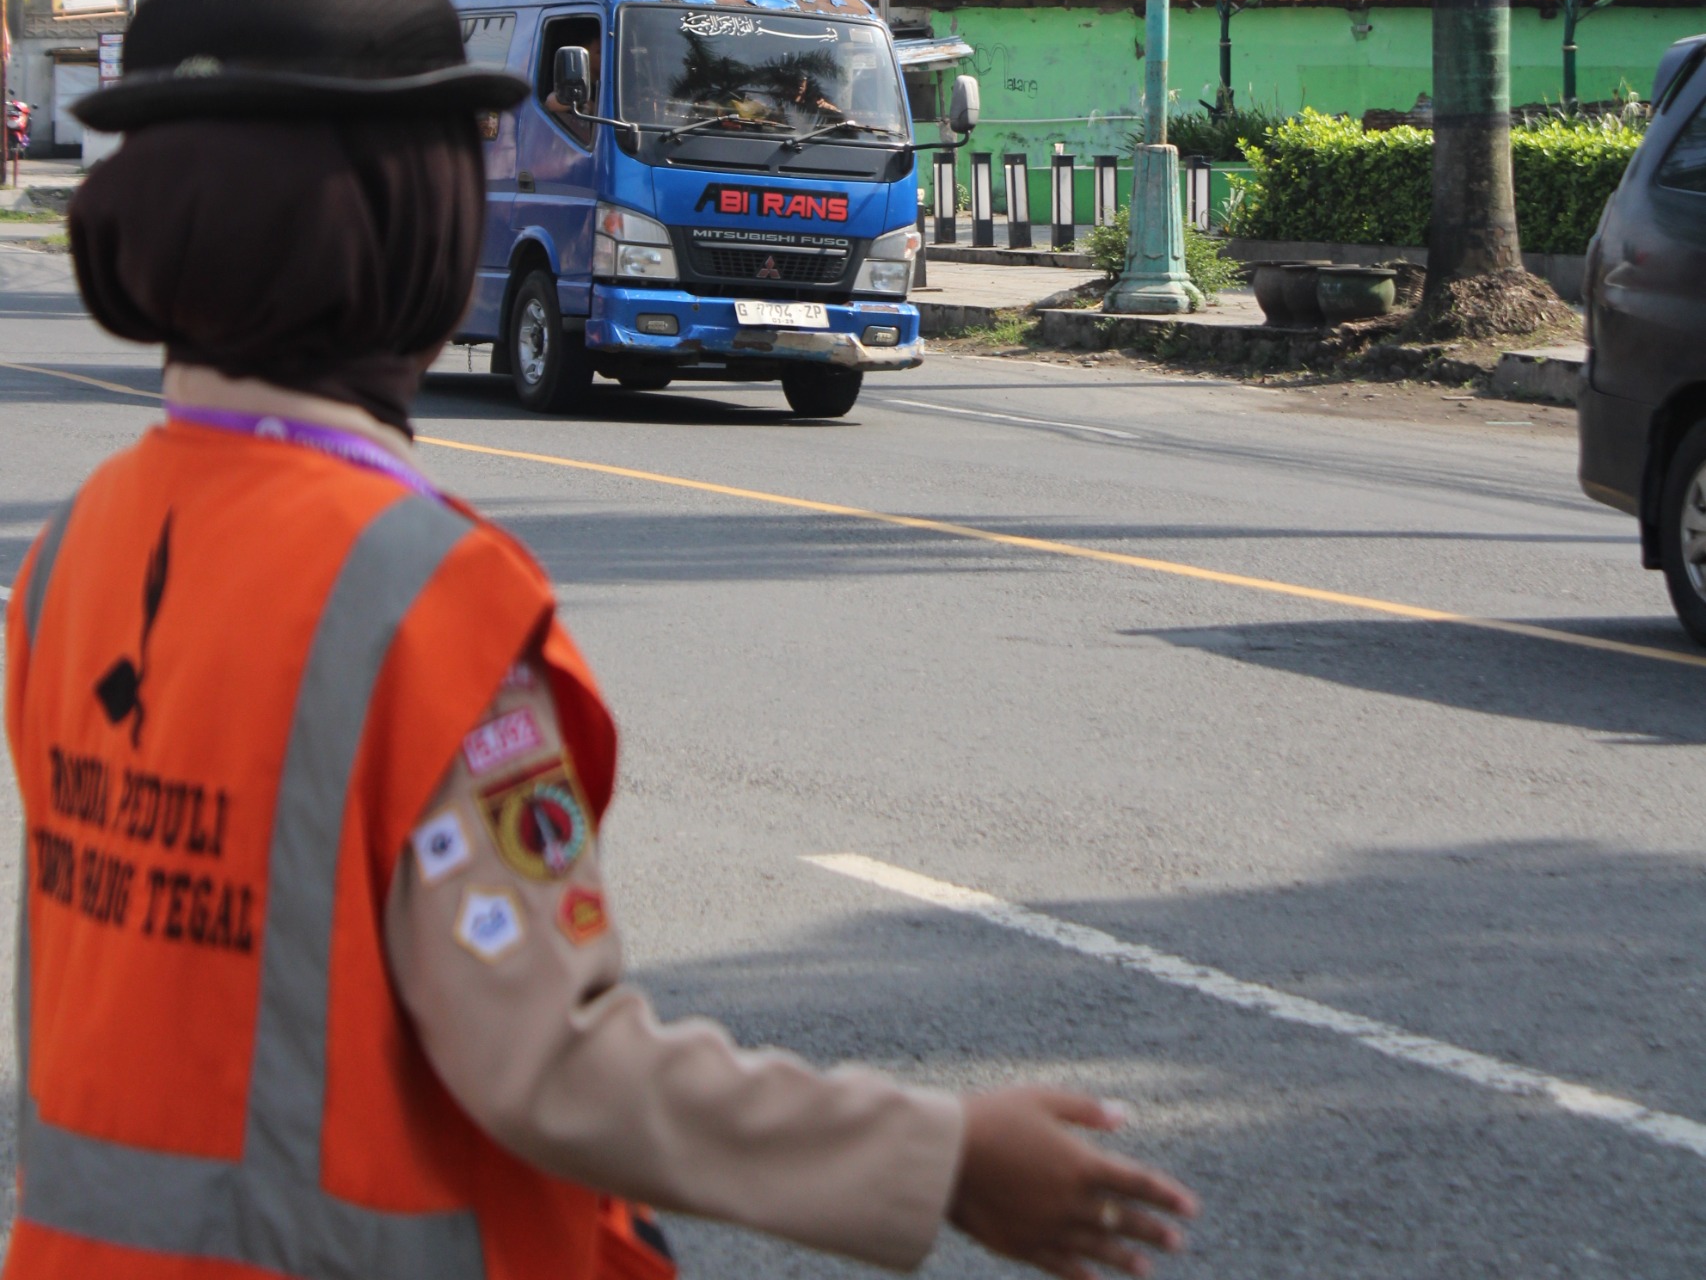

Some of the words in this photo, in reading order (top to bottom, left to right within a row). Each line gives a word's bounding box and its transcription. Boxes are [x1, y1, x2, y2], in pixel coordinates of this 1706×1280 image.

[693, 229, 795, 243] MITSUBISHI
[801, 236, 849, 246] FUSO
[737, 303, 748, 316] G
[804, 305, 821, 318] ZP
[113, 767, 229, 859] PEDULI
[141, 868, 255, 955] TEGAL
